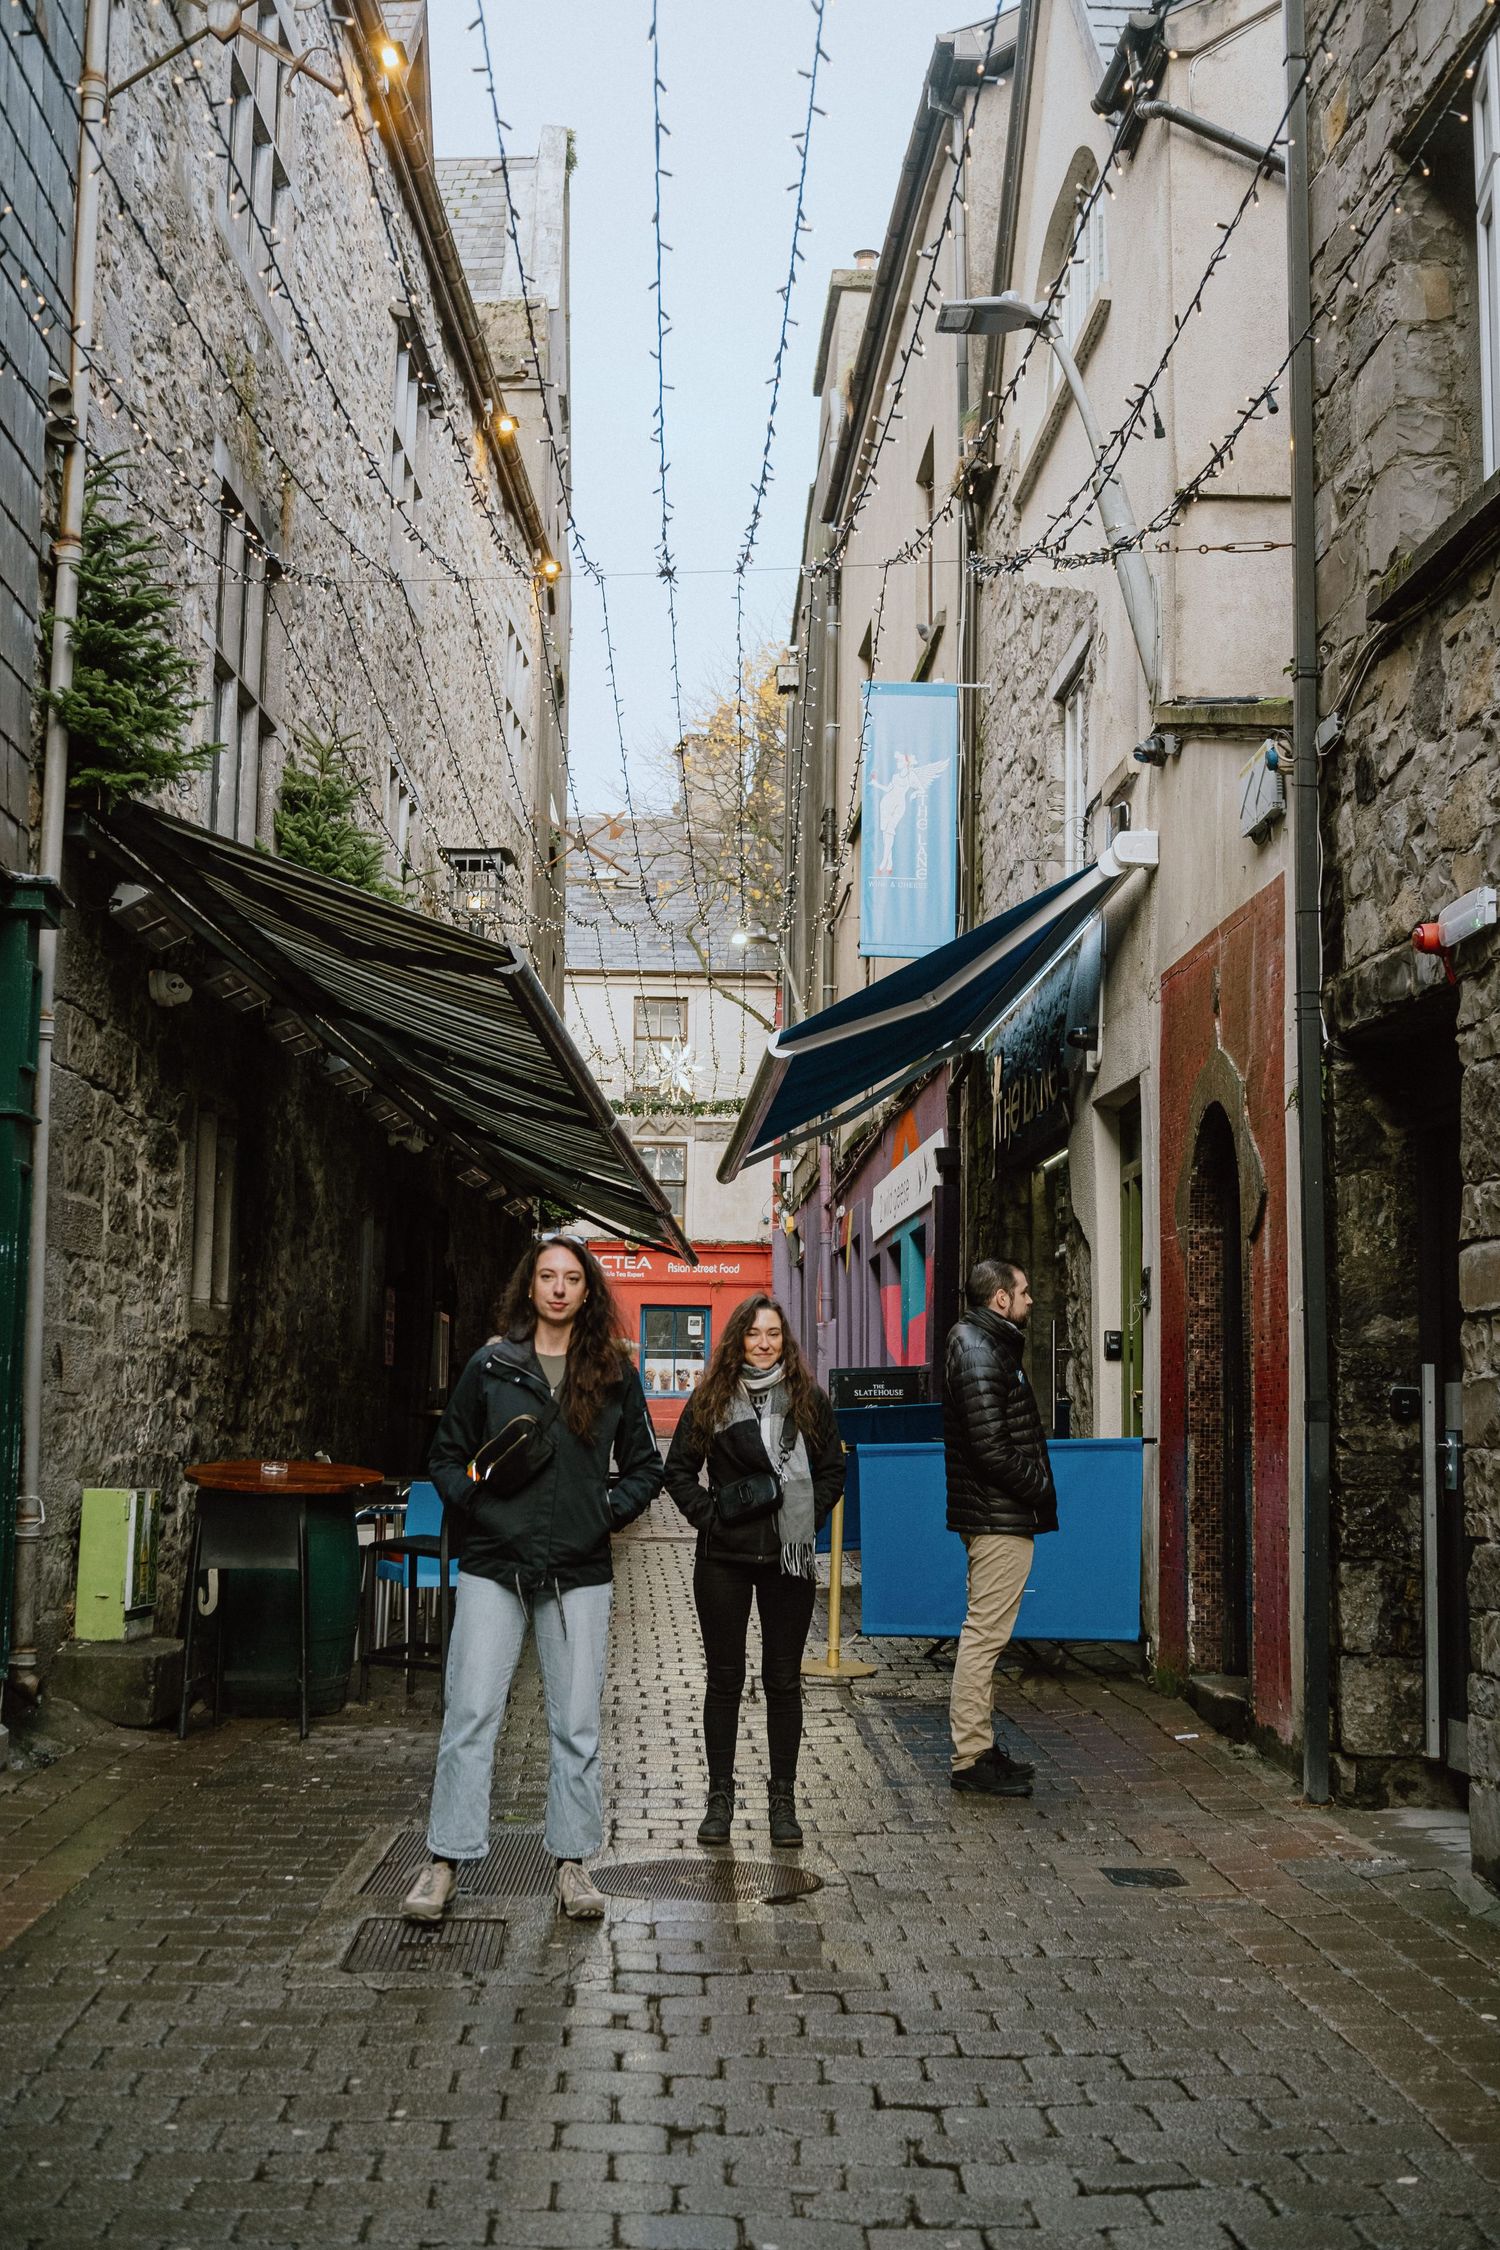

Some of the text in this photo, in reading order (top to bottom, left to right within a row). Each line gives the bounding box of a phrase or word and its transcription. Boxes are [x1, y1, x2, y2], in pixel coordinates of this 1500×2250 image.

[667, 1262, 691, 1273] Asian
[719, 1263, 740, 1274] Food
[854, 1389, 904, 1397] SLATEHOUSE
